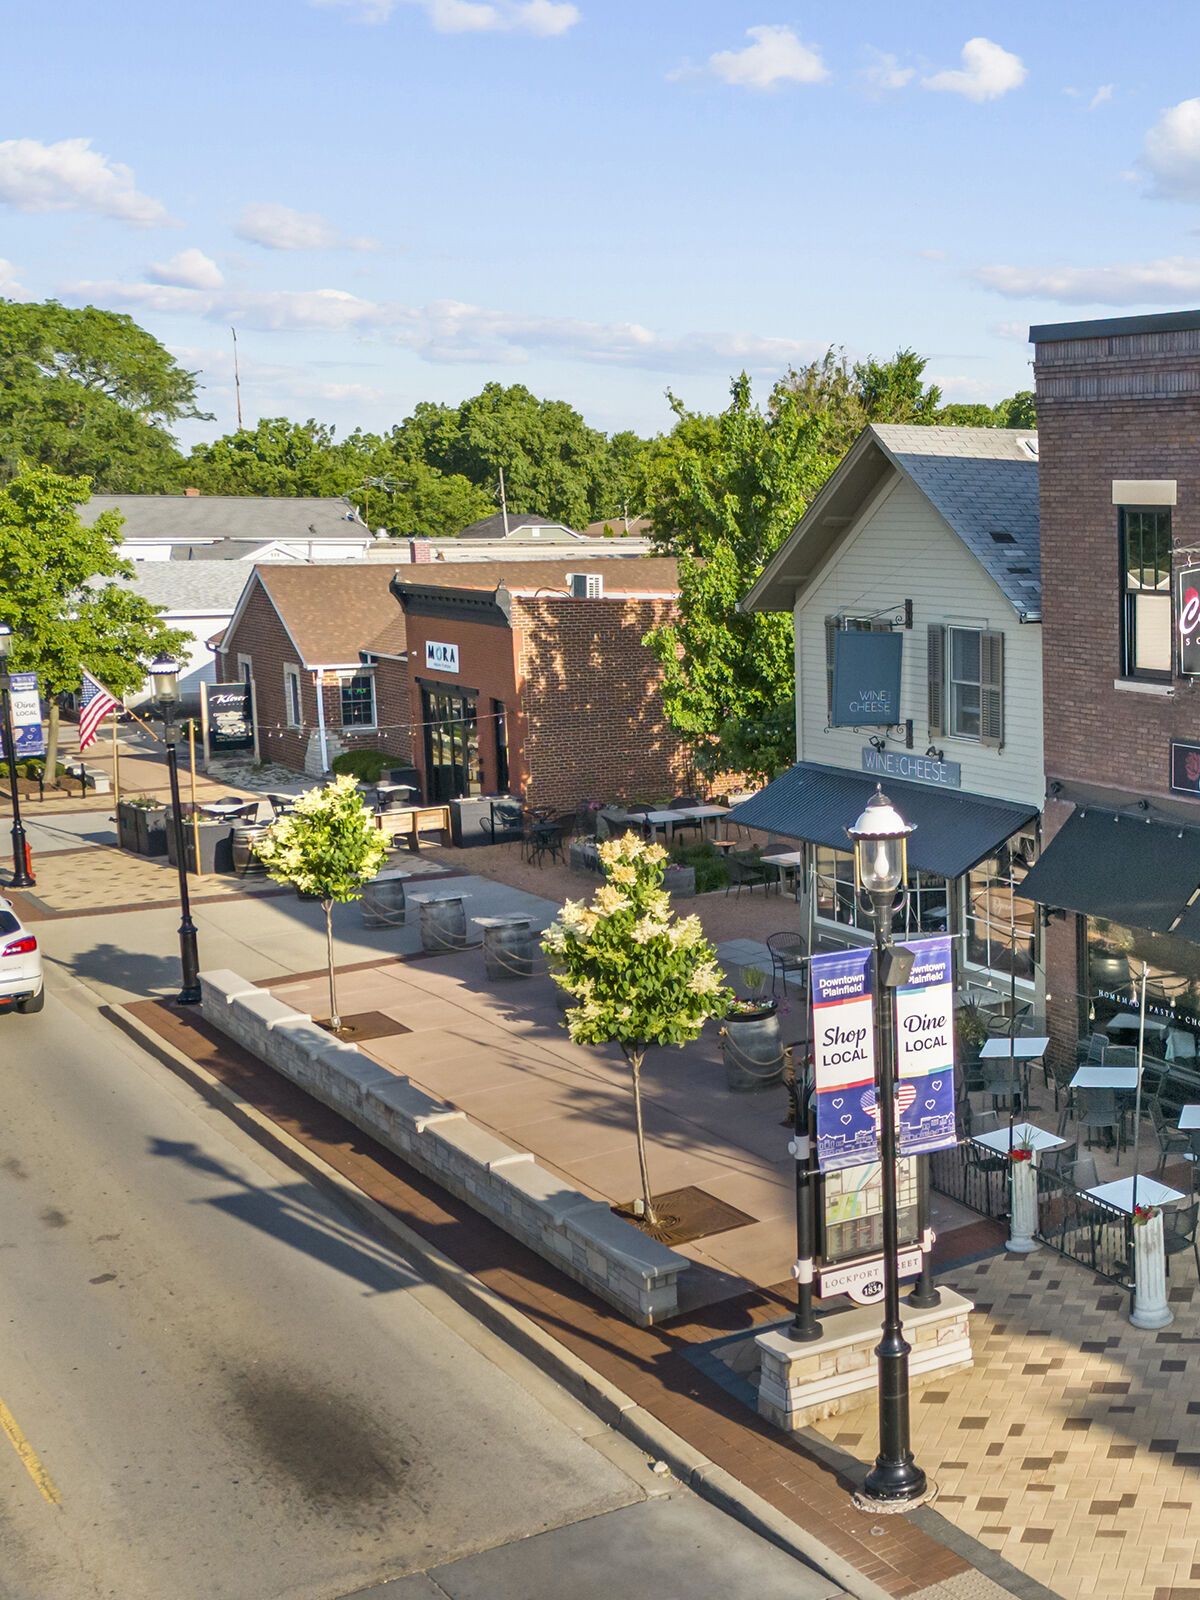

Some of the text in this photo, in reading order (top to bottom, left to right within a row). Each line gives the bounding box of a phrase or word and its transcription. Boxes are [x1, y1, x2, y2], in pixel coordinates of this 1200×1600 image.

[428, 645, 455, 663] MORA
[859, 690, 887, 701] WINE
[849, 701, 891, 713] CHEESE
[865, 750, 894, 773] WINE
[900, 757, 947, 783] CHEESE
[910, 962, 946, 975] owntown
[819, 973, 865, 989] Downtown
[822, 984, 863, 998] Plainfield
[1098, 989, 1141, 1008] HOMEMAD
[1149, 1005, 1175, 1019] PASTA
[903, 1014, 947, 1033] Dine
[822, 1026, 867, 1048] Shop
[905, 1035, 948, 1053] LOCAL
[822, 1048, 868, 1067] LOCAL
[825, 1268, 880, 1289] LOCKPORT
[864, 1283, 882, 1296] 1834
